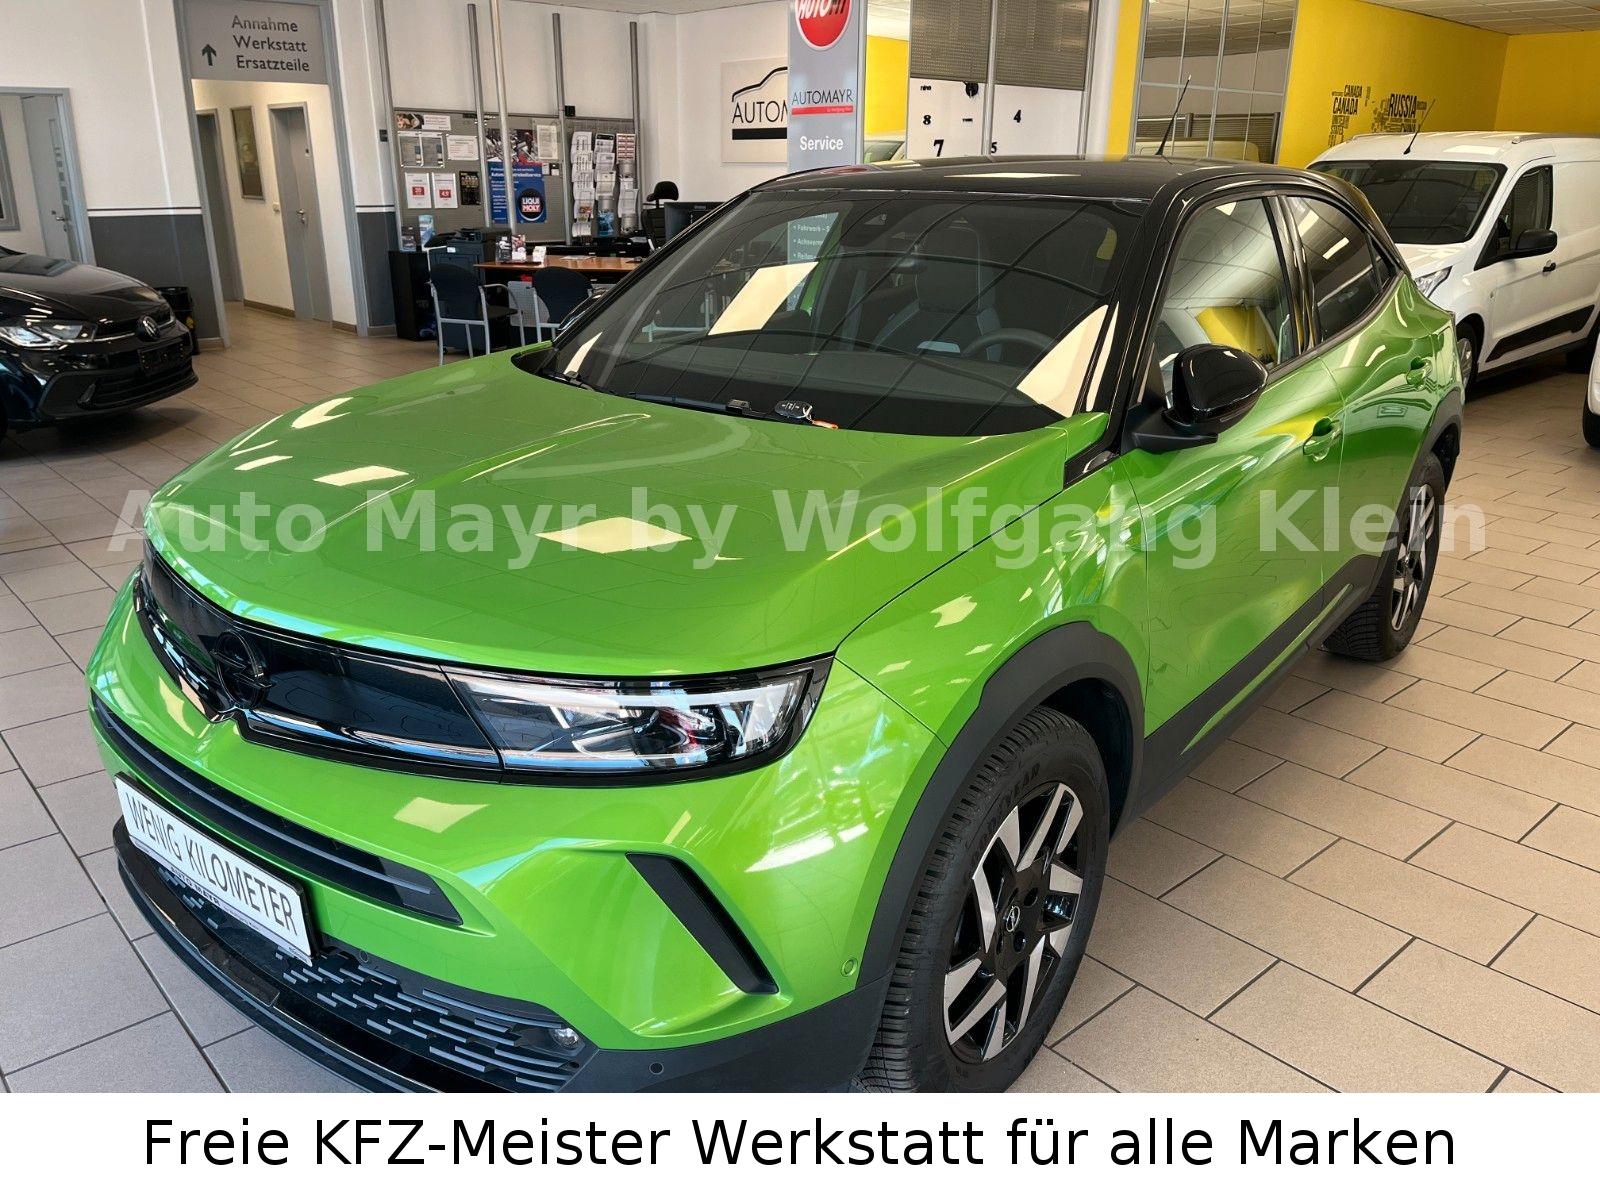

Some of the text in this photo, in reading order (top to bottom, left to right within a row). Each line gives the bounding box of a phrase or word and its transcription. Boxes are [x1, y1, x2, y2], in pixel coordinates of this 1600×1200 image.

[231, 14, 298, 32] Annahme
[233, 35, 307, 52] Werkstatt
[236, 55, 309, 71] Ersatzteile
[791, 89, 854, 106] AUTOMAYR
[1344, 85, 1363, 98] CANADA
[1333, 97, 1358, 115] CANADA
[1388, 93, 1417, 118] RUSSIA
[923, 115, 931, 125] 8
[1013, 110, 1022, 123] 4
[799, 136, 844, 151] Service
[934, 139, 944, 157] 7
[991, 142, 998, 154] 5
[522, 204, 541, 212] MOLY
[126, 792, 298, 936] WENIG KILOMETER
